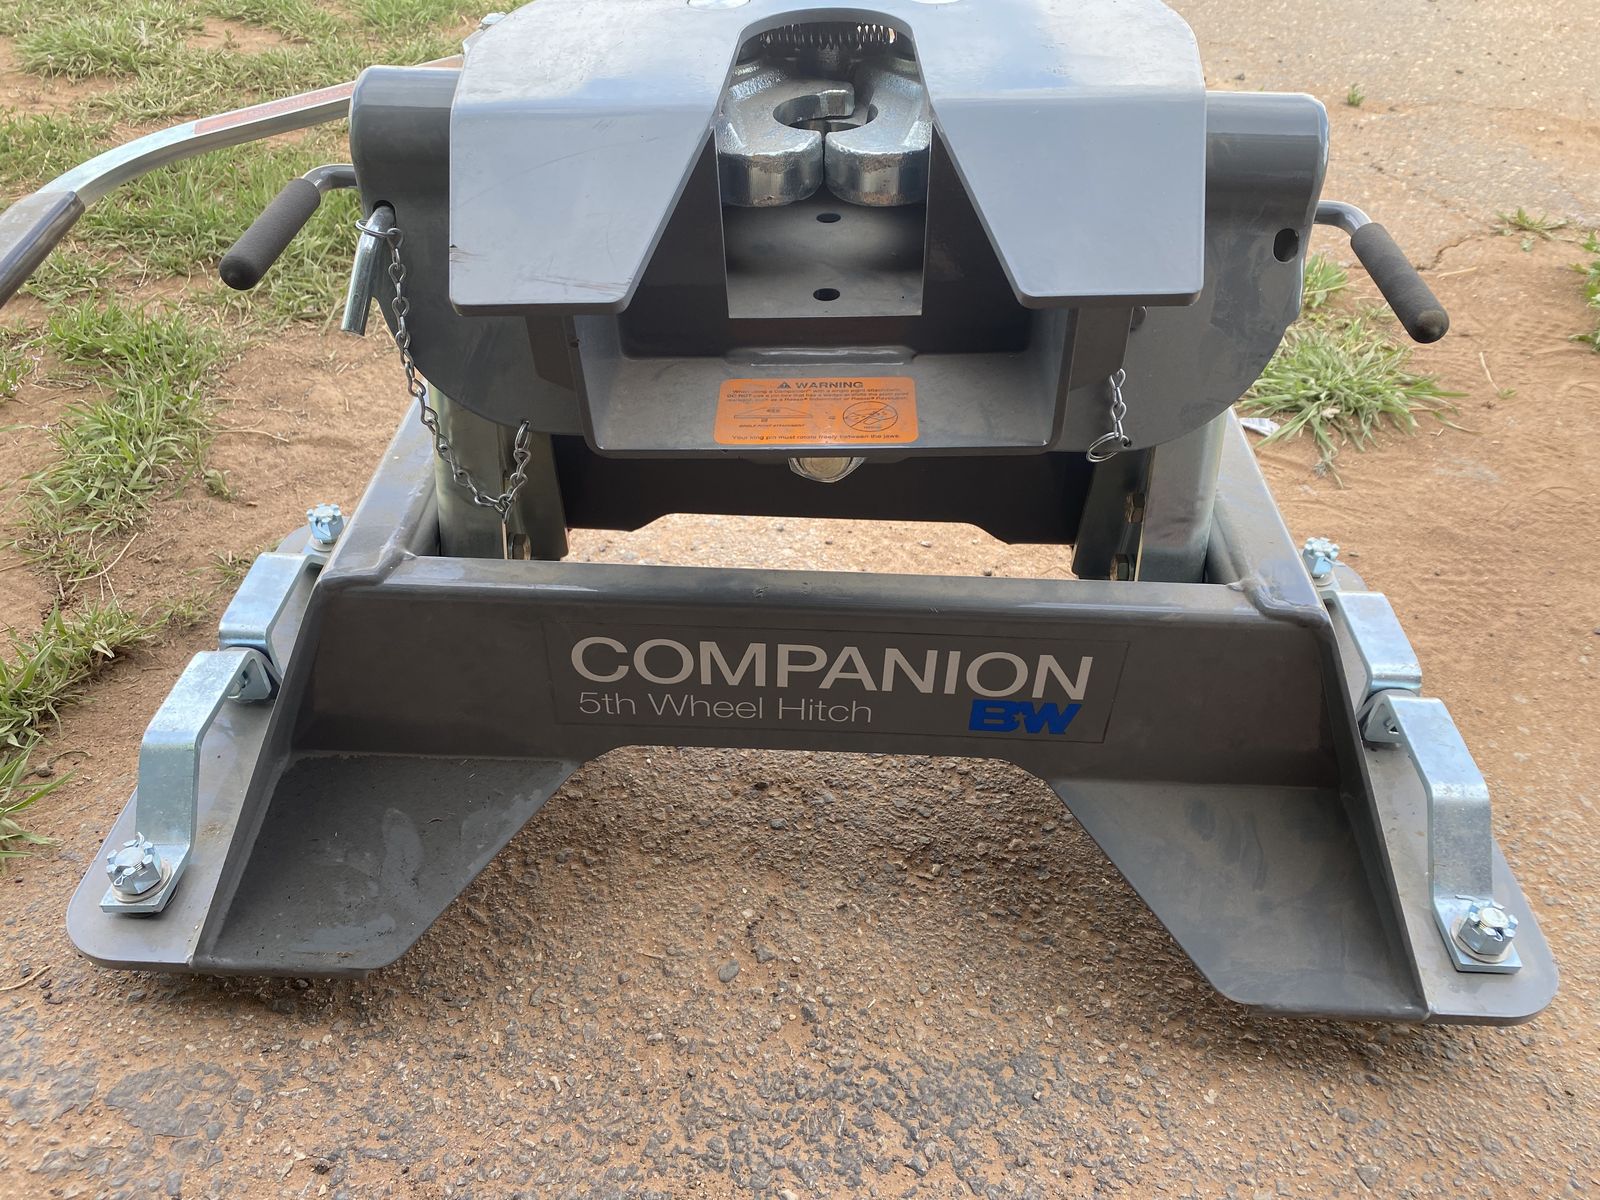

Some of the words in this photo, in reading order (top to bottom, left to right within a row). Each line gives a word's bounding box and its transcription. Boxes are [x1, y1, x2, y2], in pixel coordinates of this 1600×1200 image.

[795, 381, 864, 389] WARNING
[570, 636, 1094, 701] COMPANION
[579, 691, 636, 715] 5th
[647, 693, 763, 719] Wheel
[778, 697, 872, 723] Hitch
